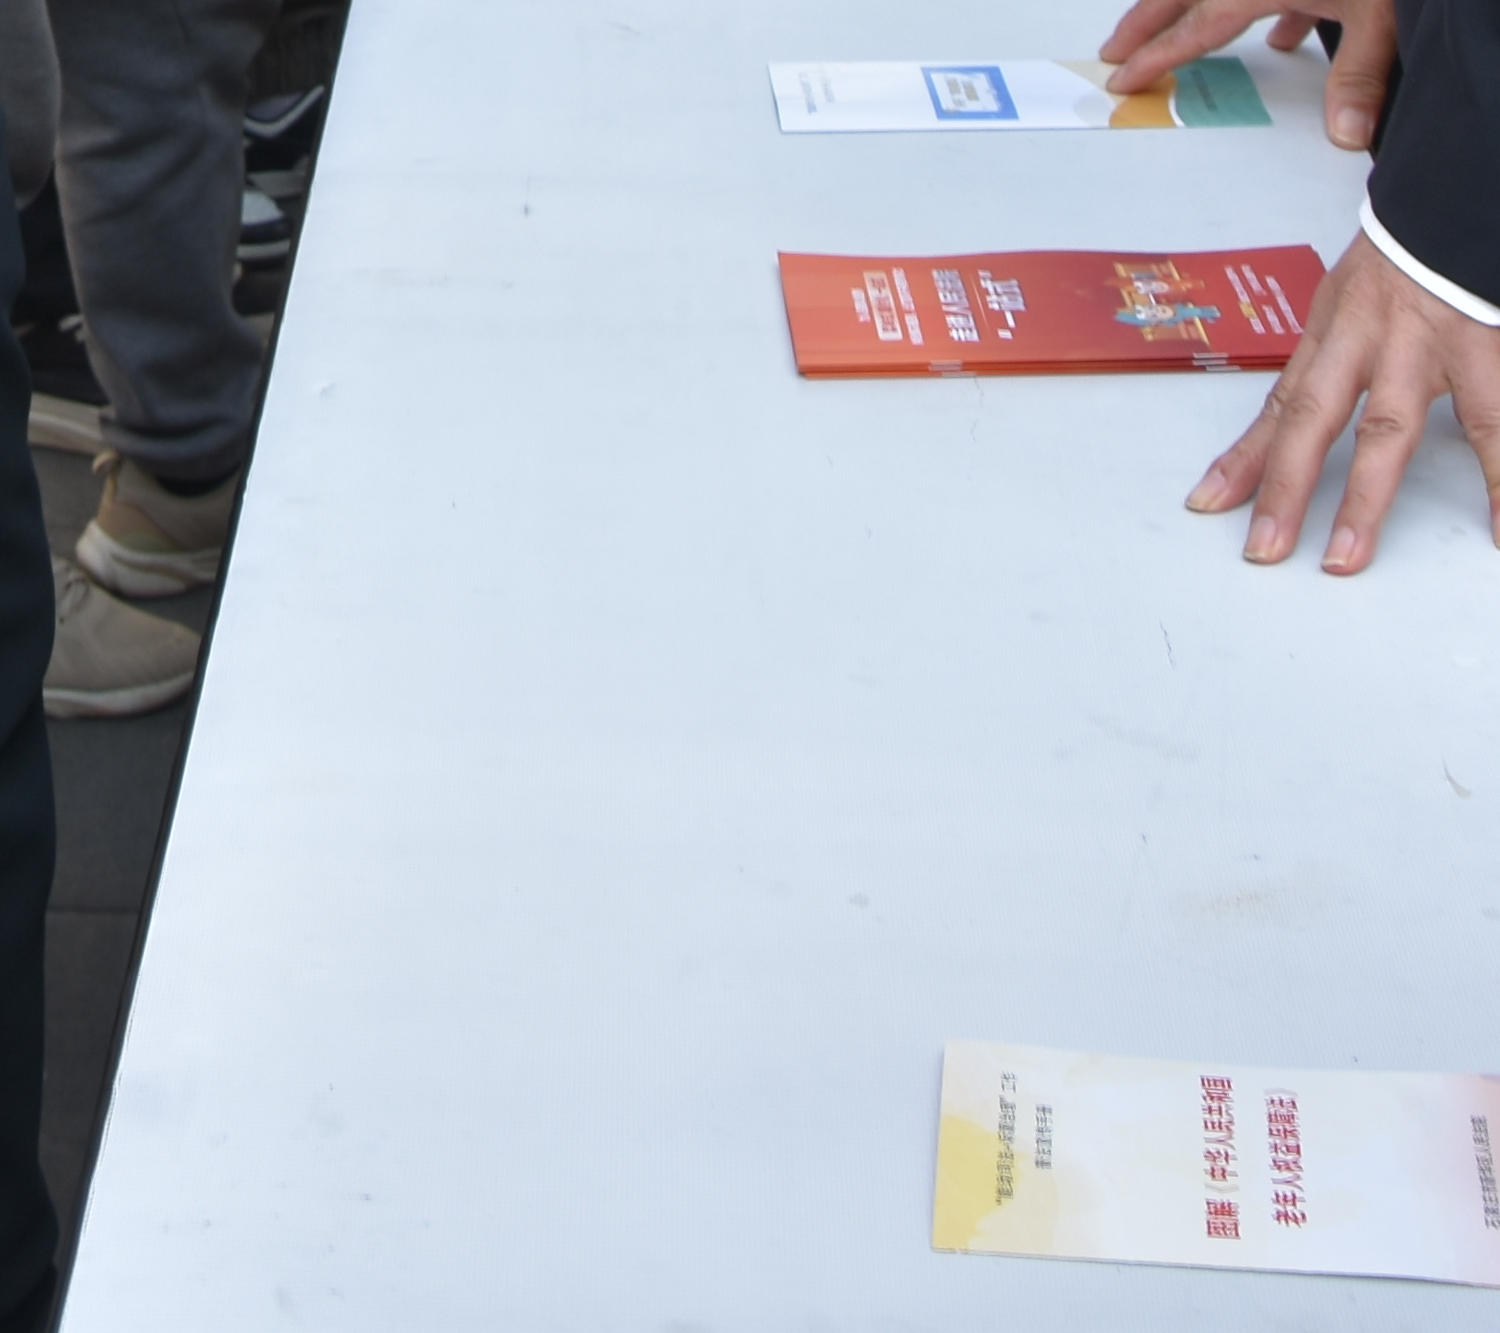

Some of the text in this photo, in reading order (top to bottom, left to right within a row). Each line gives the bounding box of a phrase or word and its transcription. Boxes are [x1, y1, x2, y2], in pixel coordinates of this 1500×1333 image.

[1200, 1075, 1241, 1239] 图解《中华人民共和国
[1264, 1087, 1308, 1228] 老年人权益保障法》
